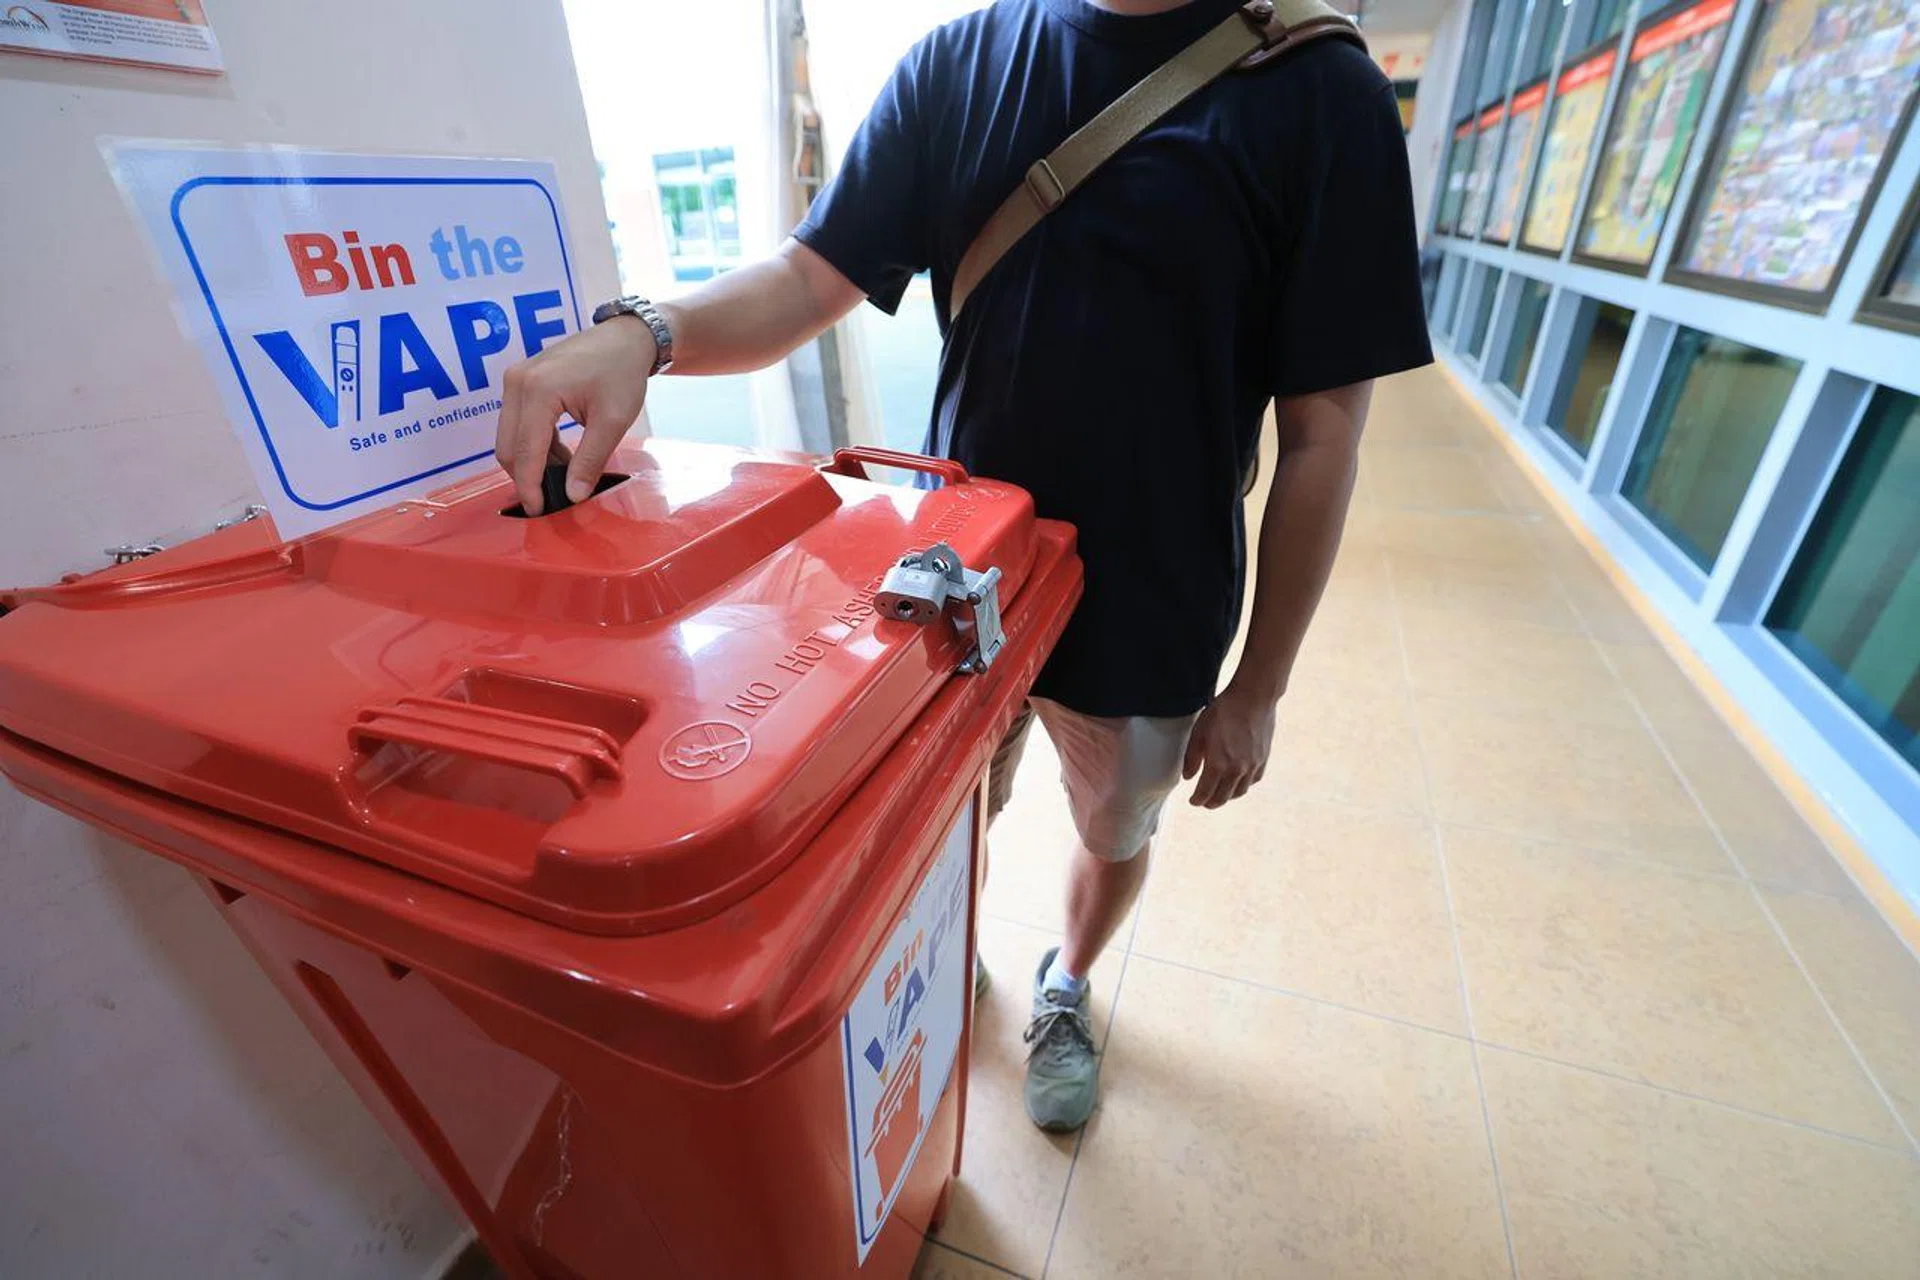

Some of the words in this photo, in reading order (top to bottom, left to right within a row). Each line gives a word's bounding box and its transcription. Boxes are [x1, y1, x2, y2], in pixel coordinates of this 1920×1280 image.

[284, 230, 416, 297] Bin
[429, 225, 524, 281] the
[252, 289, 567, 429] VAPE
[350, 432, 387, 451] Safe
[394, 421, 422, 439] and
[428, 399, 502, 429] confidentia
[725, 682, 782, 717] NO
[774, 630, 838, 675] HOT
[832, 574, 884, 629] ASHE
[884, 927, 923, 1006] Bin
